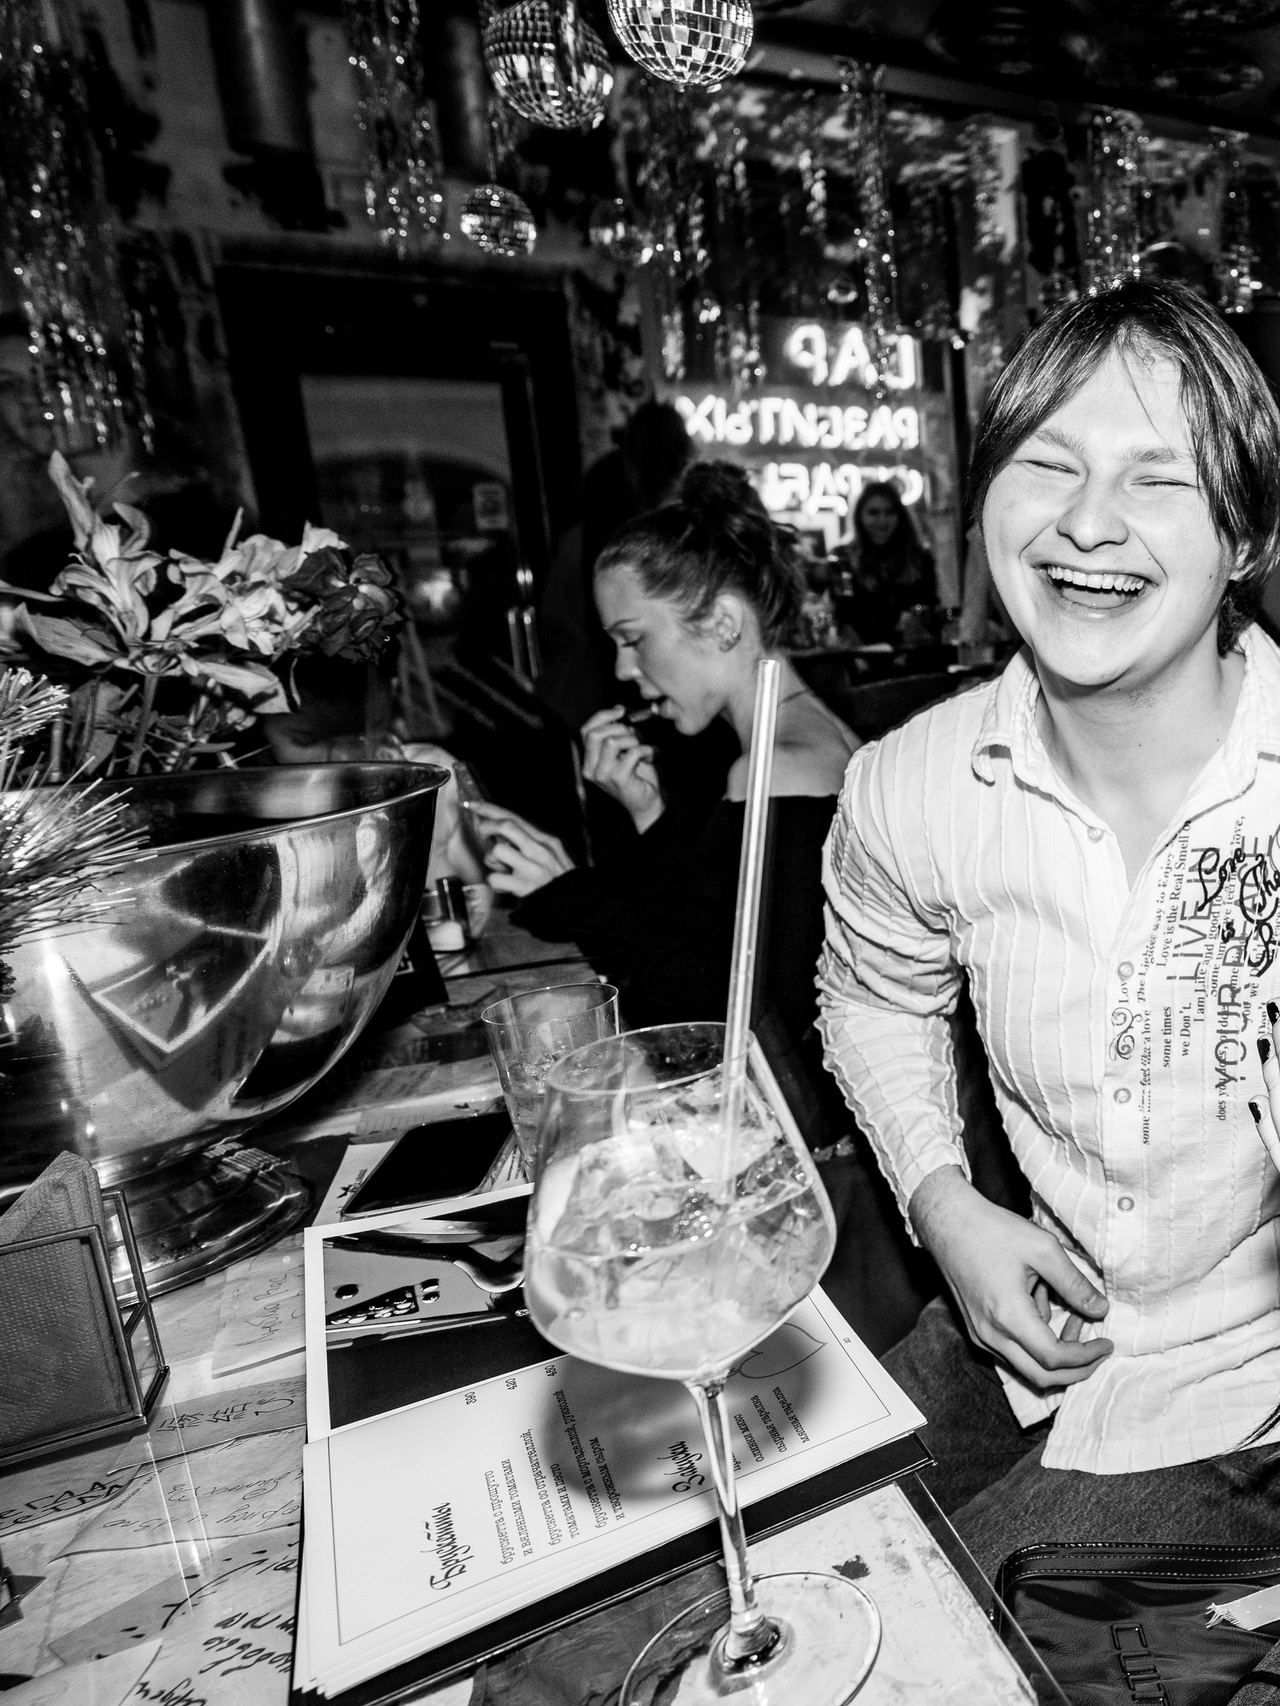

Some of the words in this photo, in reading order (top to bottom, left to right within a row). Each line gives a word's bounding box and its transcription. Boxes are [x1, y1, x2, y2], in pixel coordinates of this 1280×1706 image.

[1174, 835, 1191, 870] Smell
[1186, 846, 1221, 884] IN
[1169, 873, 1185, 901] Real
[1165, 904, 1180, 924] the
[1207, 910, 1222, 940] good
[1222, 908, 1232, 925] we
[1163, 925, 1175, 935] is
[1166, 900, 1214, 981] LIVE
[1156, 938, 1174, 967] Love
[1200, 943, 1215, 966] and
[1249, 943, 1262, 978] Dn't
[1194, 968, 1208, 994] Life
[1249, 982, 1260, 998] we
[1160, 1005, 1172, 1036] times
[1178, 1001, 1192, 1038] Don't.
[1196, 997, 1206, 1015] am
[1181, 1040, 1190, 1056] we
[1214, 983, 1250, 1089] YOUR
[1162, 1037, 1172, 1068] some
[1216, 1100, 1227, 1121] does
[1142, 1115, 1151, 1145] some
[505, 1377, 519, 1391] 420
[552, 1388, 579, 1424] рукколой
[749, 1394, 775, 1425] тарелка
[771, 1386, 795, 1416] тарелка
[732, 1413, 753, 1434] мико
[764, 1423, 788, 1453] сырная
[787, 1414, 810, 1443] мясная
[565, 1423, 592, 1478] мортаделлой,
[587, 1436, 607, 1464] сыром
[742, 1432, 765, 1463] оливки
[501, 1458, 520, 1500] томатами
[549, 1462, 566, 1487] песто
[657, 1440, 706, 1493] Закуски
[484, 1470, 504, 1512] прошутто
[538, 1489, 549, 1500] со
[597, 1463, 623, 1513] творожным
[559, 1493, 581, 1538] томатами
[584, 1483, 609, 1529] брускетта
[615, 1512, 626, 1521] и
[510, 1499, 533, 1548] вялеными
[541, 1499, 566, 1545] брускетта
[420, 1501, 475, 1591] Брускетты
[493, 1516, 516, 1565] брускетта
[522, 1547, 534, 1556] и
